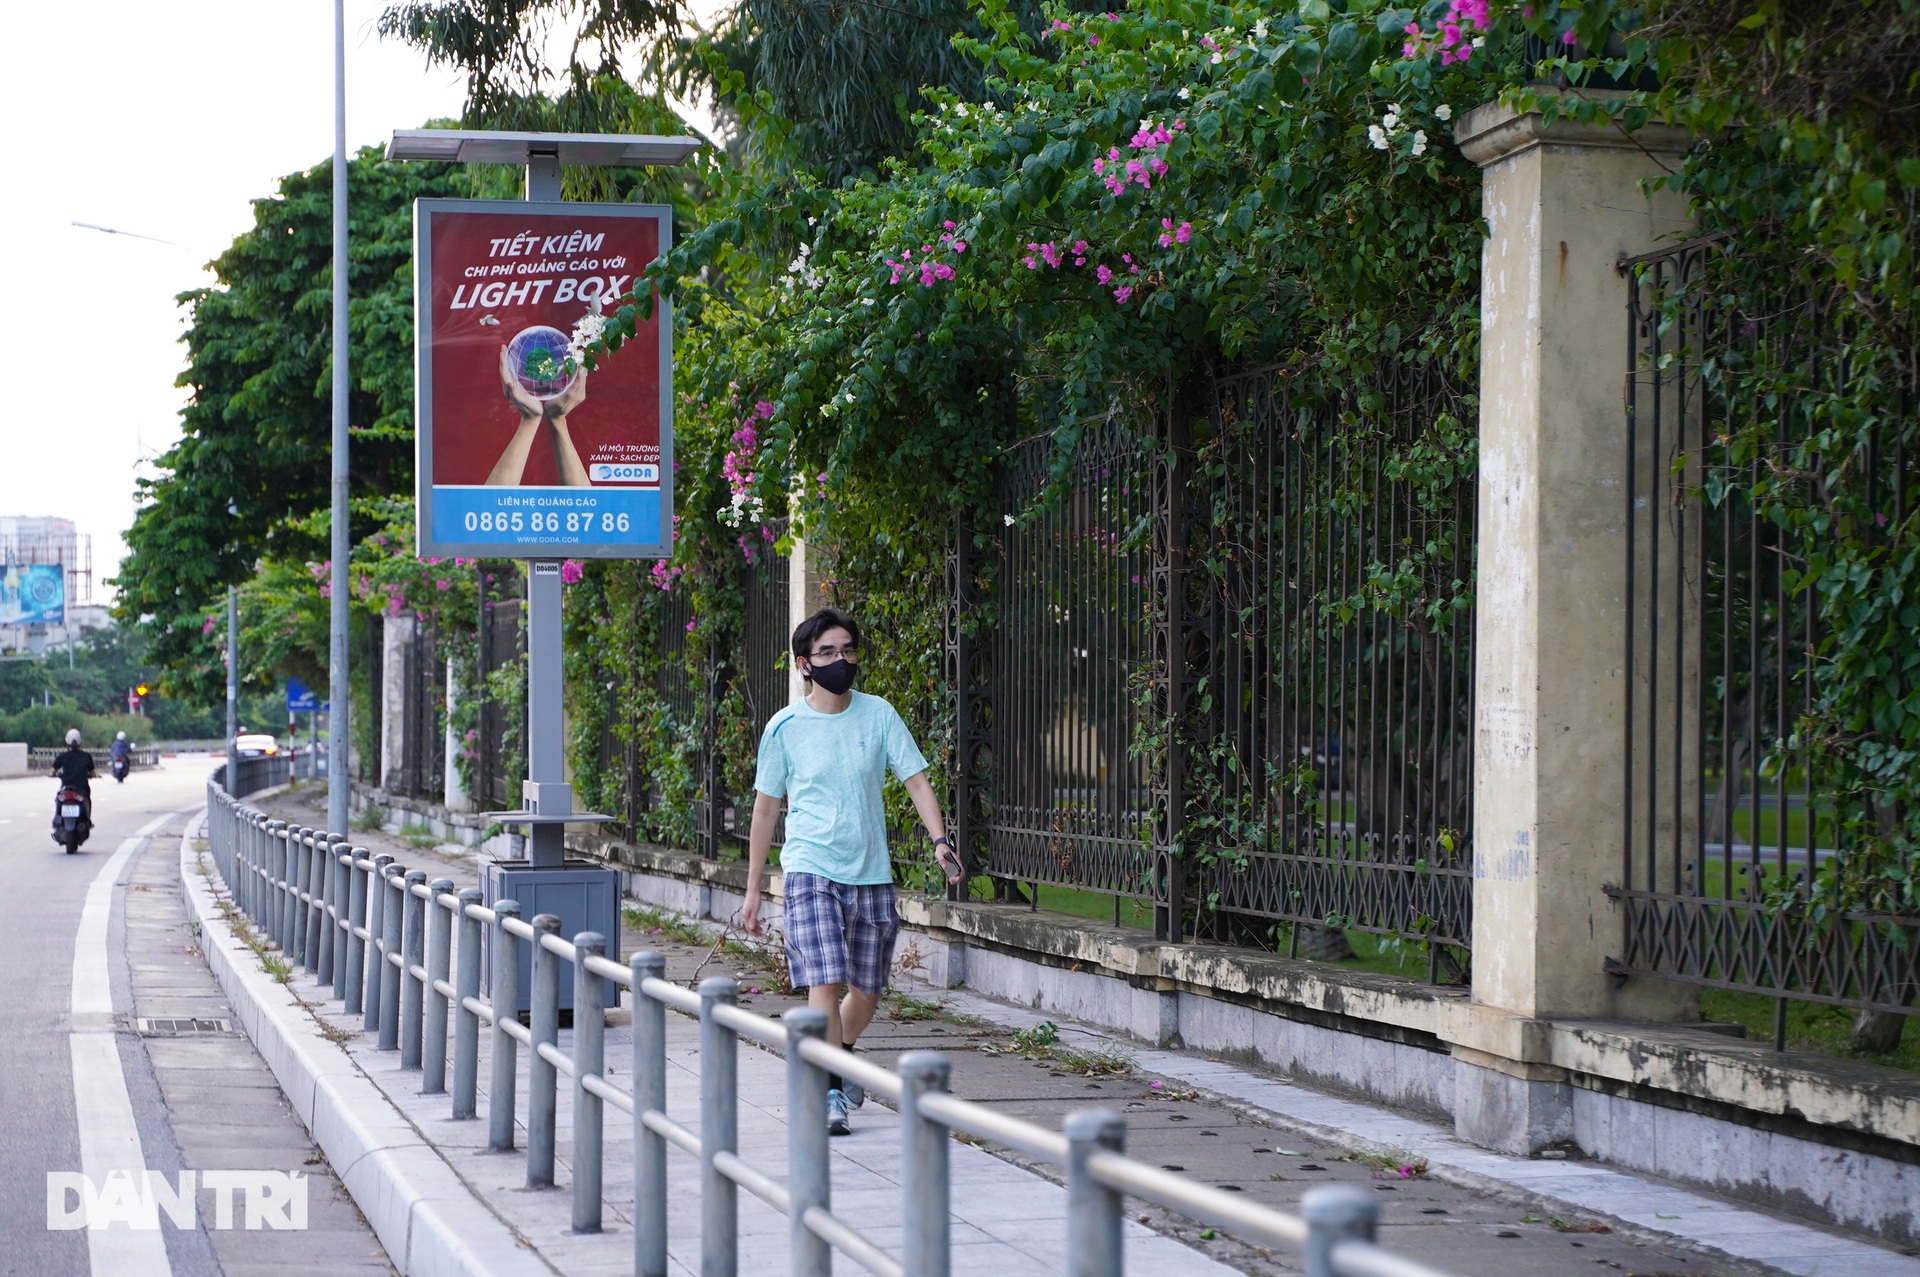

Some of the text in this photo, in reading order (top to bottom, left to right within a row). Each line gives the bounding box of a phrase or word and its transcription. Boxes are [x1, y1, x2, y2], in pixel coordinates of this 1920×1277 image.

[489, 229, 605, 258] TIẾT KIỆM
[464, 255, 627, 277] CHI PHÍ QUẢNG CÁO VỚI
[450, 275, 630, 309] LIGHT BOX
[613, 467, 652, 478] GODA
[497, 496, 520, 506] LIÊN
[575, 497, 597, 507] CÁO
[464, 512, 630, 533] 0865 86 87 86
